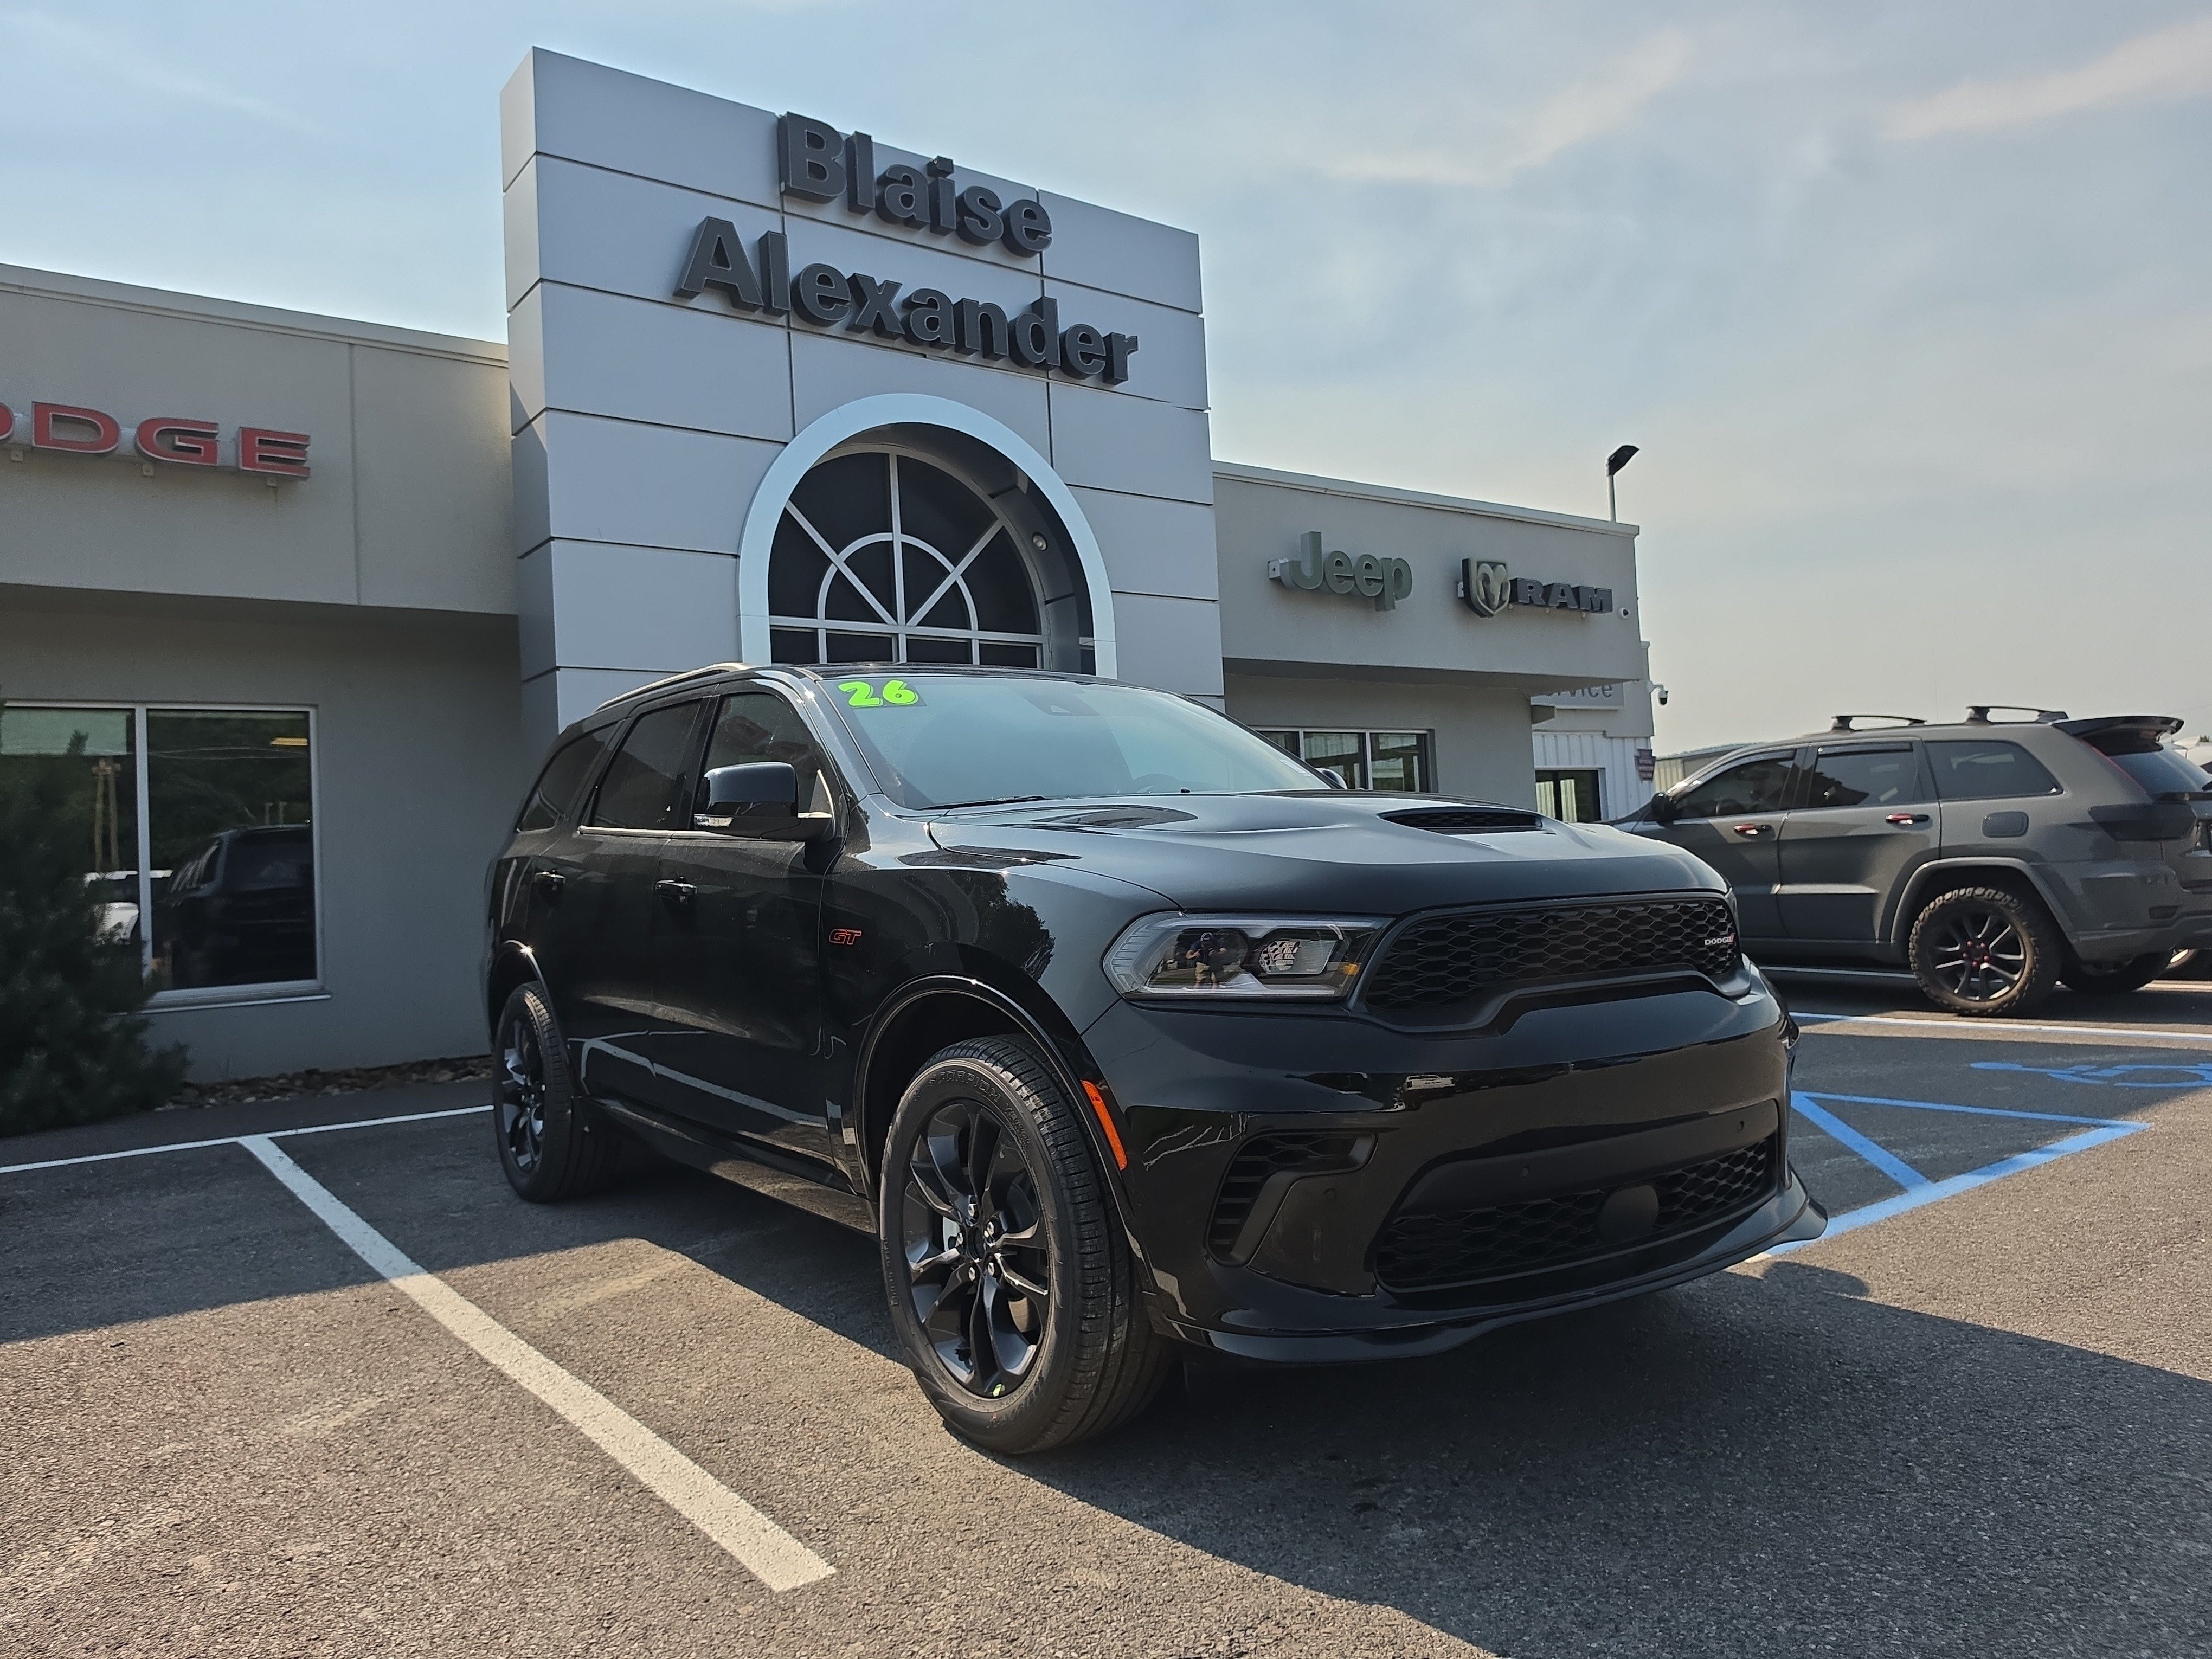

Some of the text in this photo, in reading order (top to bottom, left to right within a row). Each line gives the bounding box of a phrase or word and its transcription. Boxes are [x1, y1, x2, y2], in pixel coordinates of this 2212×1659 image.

[779, 112, 1053, 258] Blaise
[673, 215, 1139, 386] Alexander
[0, 401, 311, 481] DGE
[1285, 531, 1413, 612] Jeep
[1513, 578, 1613, 614] RAM
[838, 680, 919, 706] 26
[829, 928, 863, 946] GT
